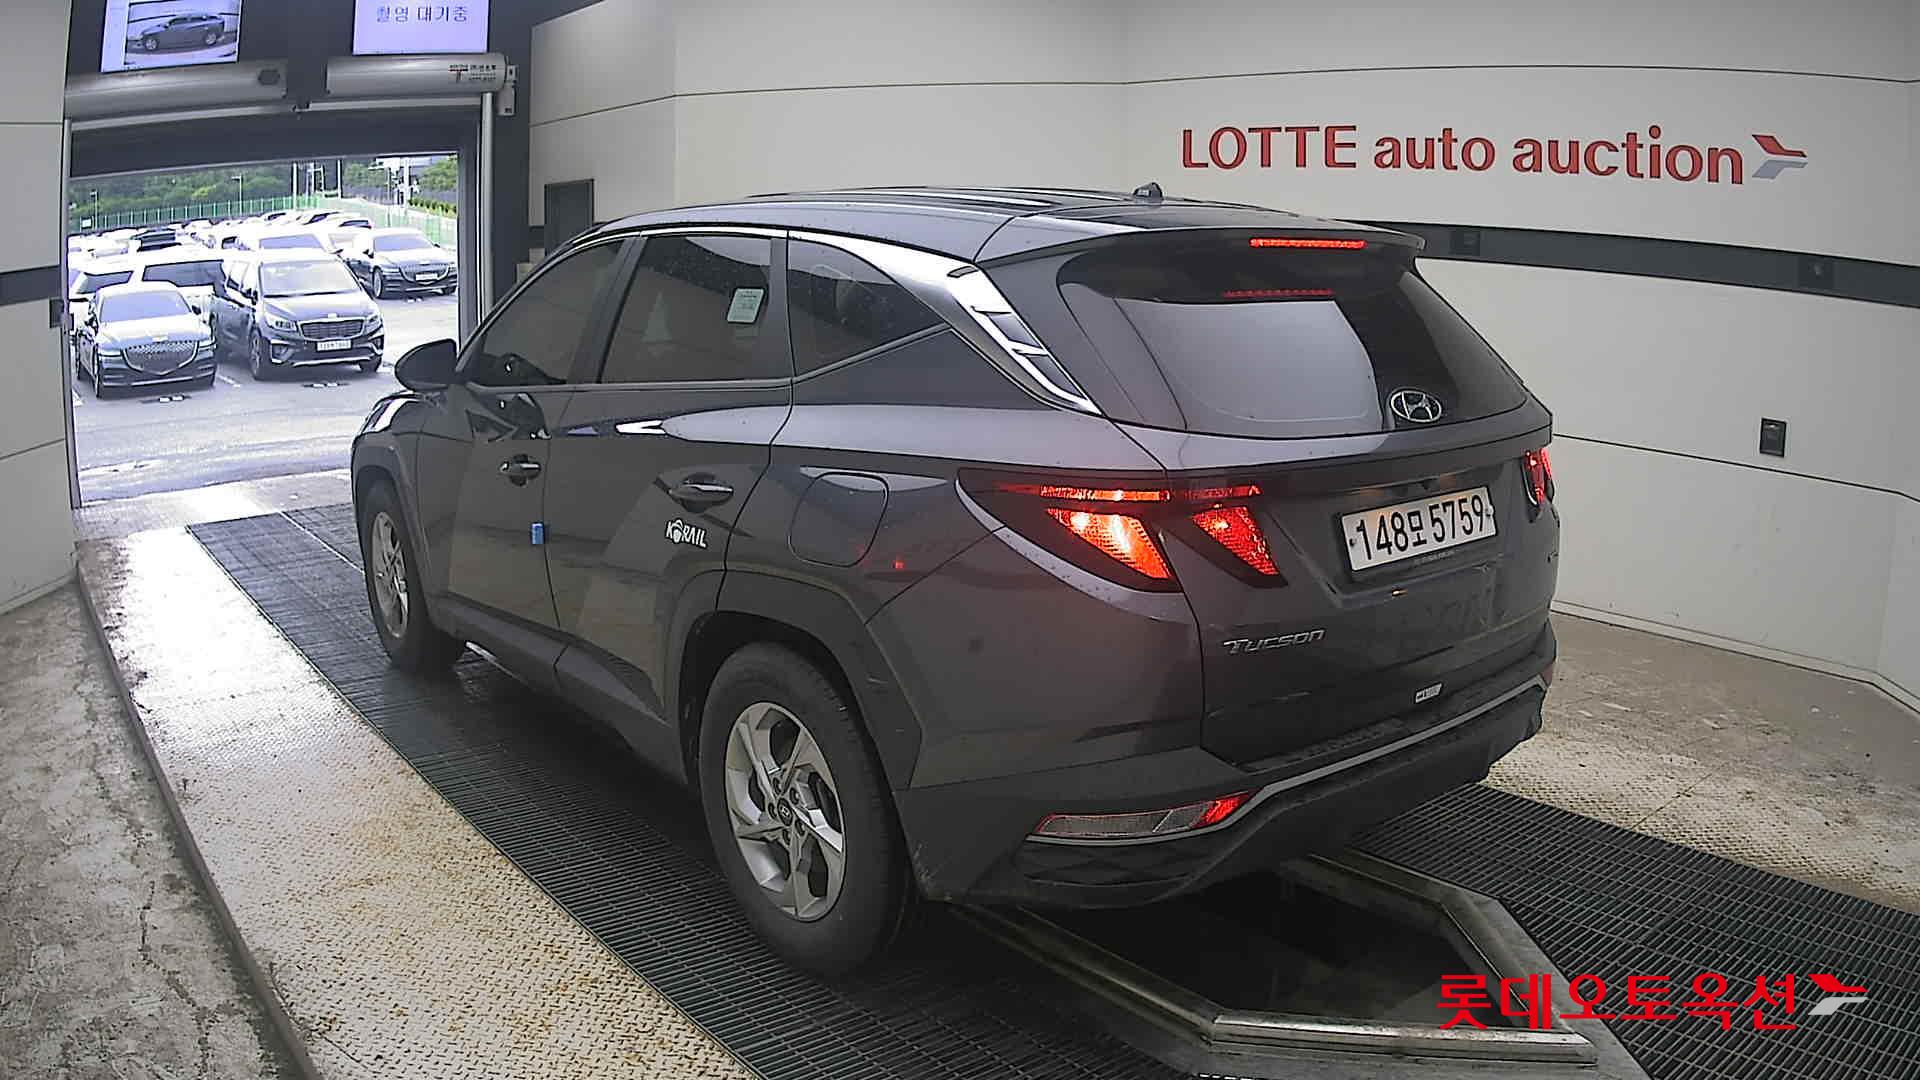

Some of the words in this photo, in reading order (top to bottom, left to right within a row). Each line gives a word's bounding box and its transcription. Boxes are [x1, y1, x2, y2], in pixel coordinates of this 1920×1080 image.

[417, 5, 468, 23] 대기중
[1182, 125, 1357, 170] LOTTE
[1374, 128, 1496, 171] auto
[1513, 125, 1744, 185] auction
[665, 519, 707, 548] KORAIL
[1356, 511, 1427, 560] 148모
[1428, 494, 1484, 543] 5759
